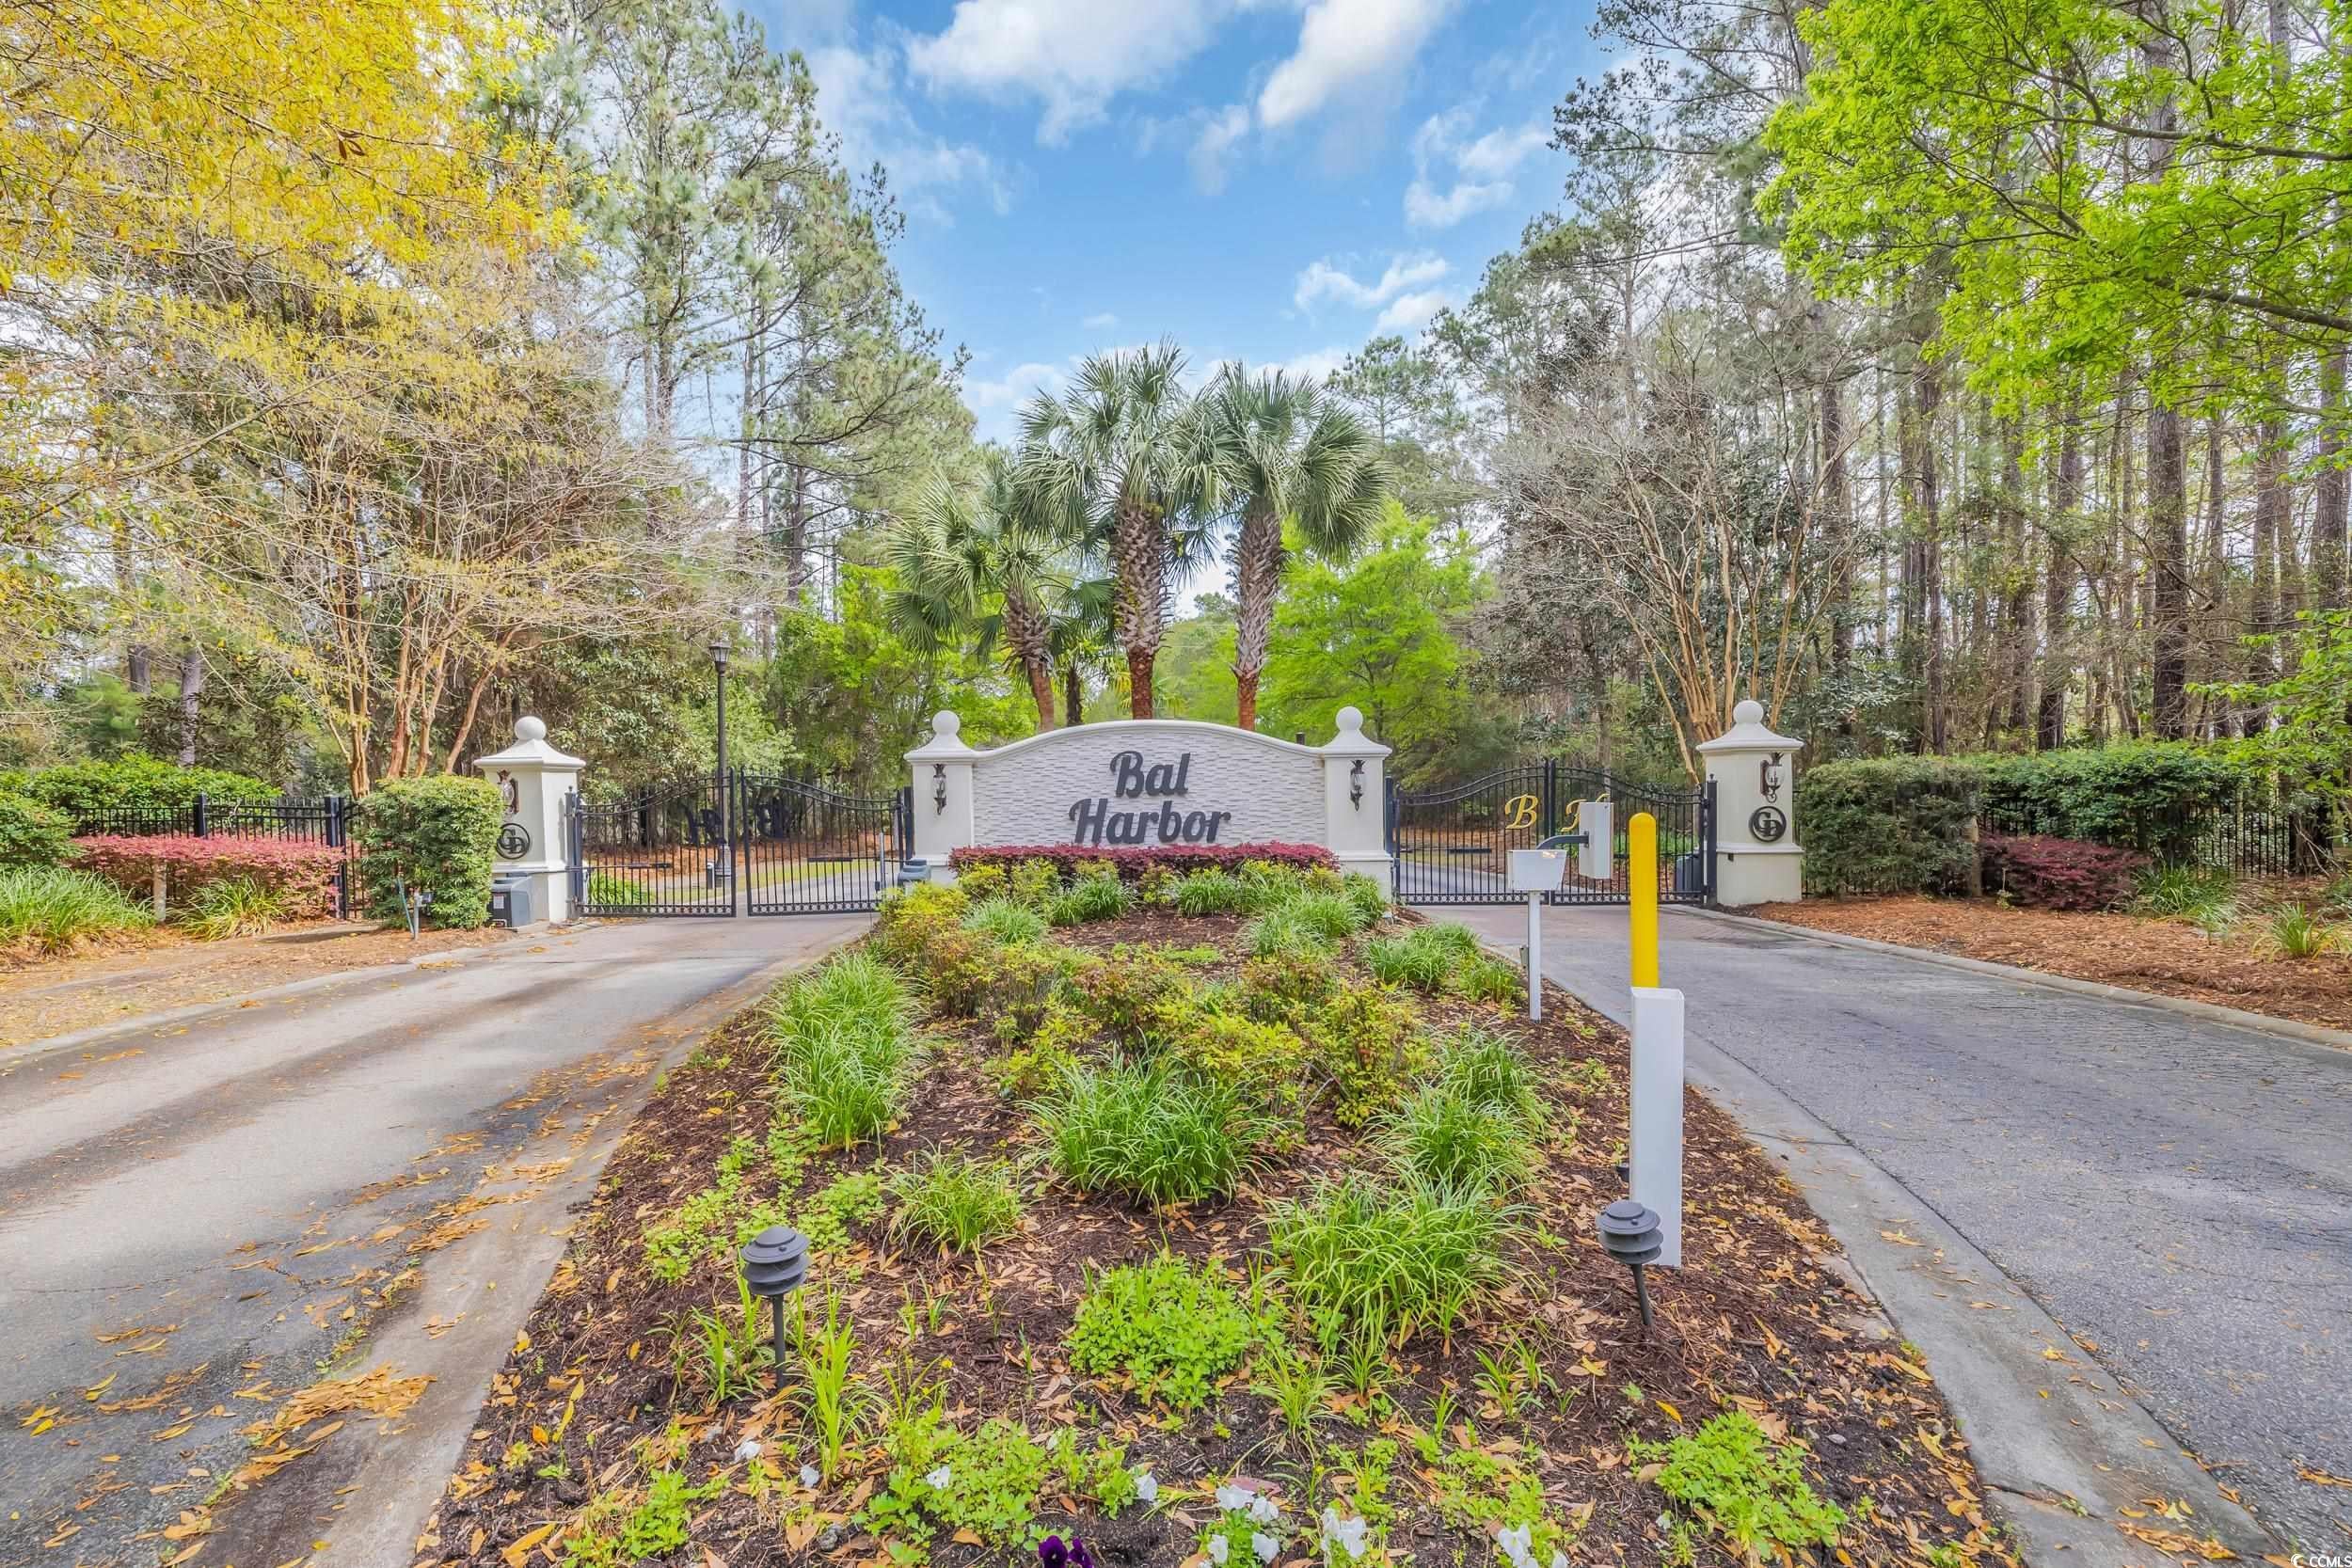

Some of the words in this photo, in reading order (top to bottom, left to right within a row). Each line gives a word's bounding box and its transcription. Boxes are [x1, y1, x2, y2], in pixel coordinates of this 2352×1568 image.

[1110, 751, 1191, 799] Bal
[1069, 798, 1232, 844] Harbor
[1504, 793, 1539, 830] B
